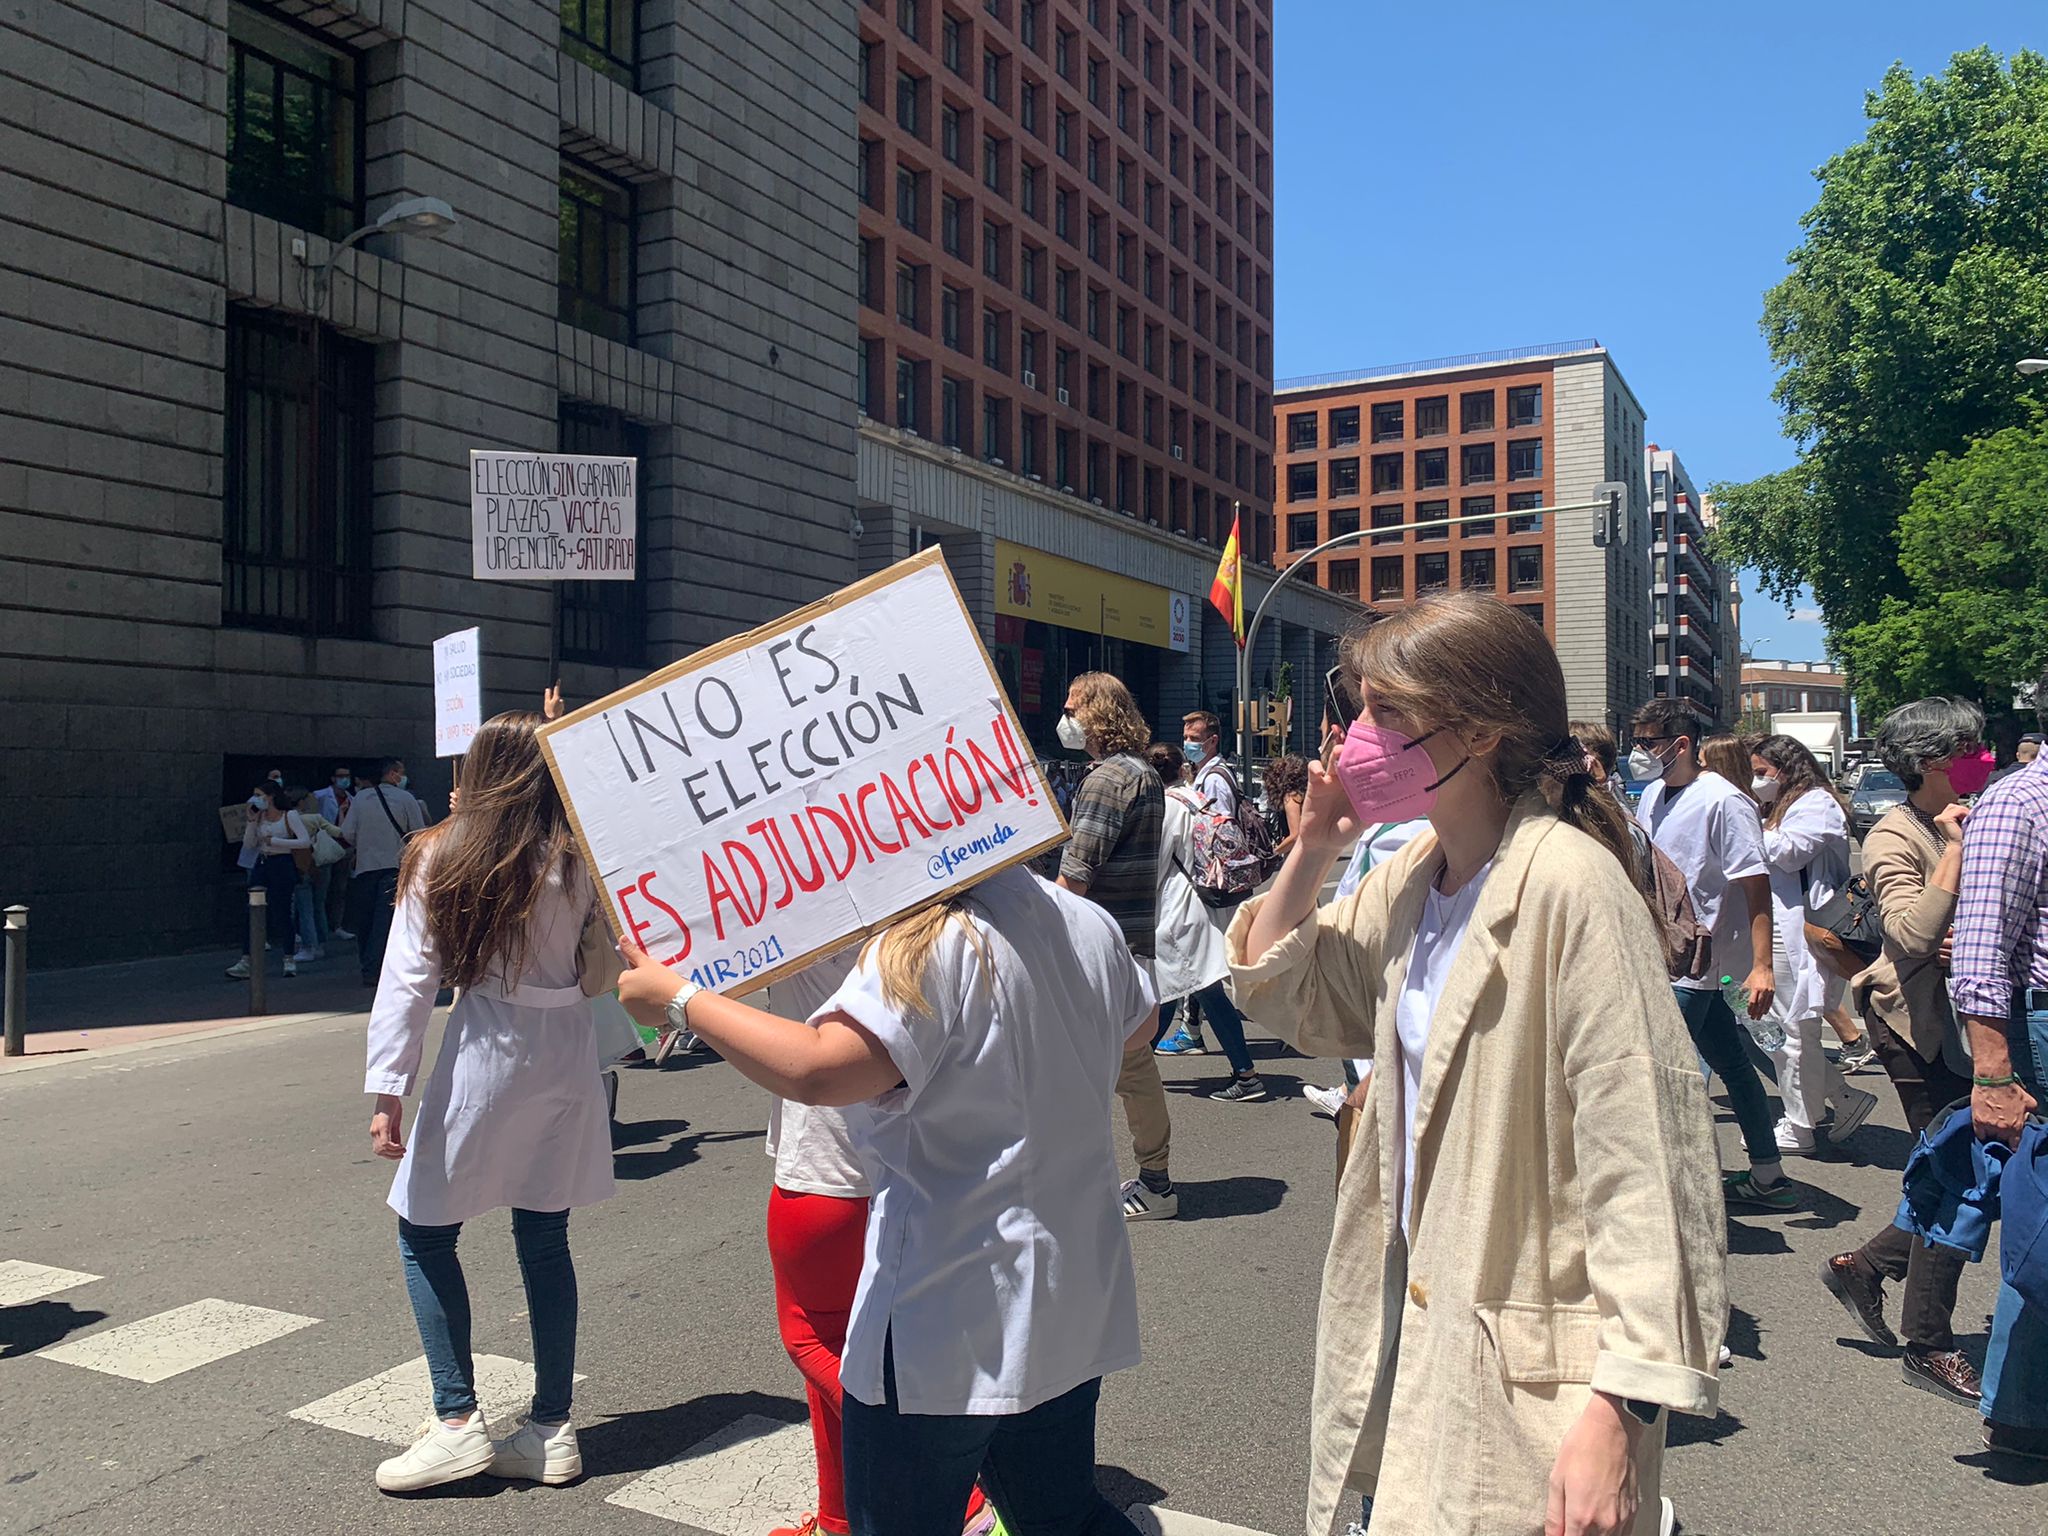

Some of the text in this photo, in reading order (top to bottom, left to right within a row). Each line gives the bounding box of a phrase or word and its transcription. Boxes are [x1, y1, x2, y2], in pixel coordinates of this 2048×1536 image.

[475, 456, 632, 497] ELECCIÓN SIN GARANTÍA
[487, 497, 621, 534] PLAZAS VACÍAS
[768, 624, 840, 708] ES
[681, 672, 924, 826] ELECCIÓN
[1393, 767, 1416, 782] FFP2
[927, 822, 1020, 879] @fseunida
[616, 870, 692, 967] ES
